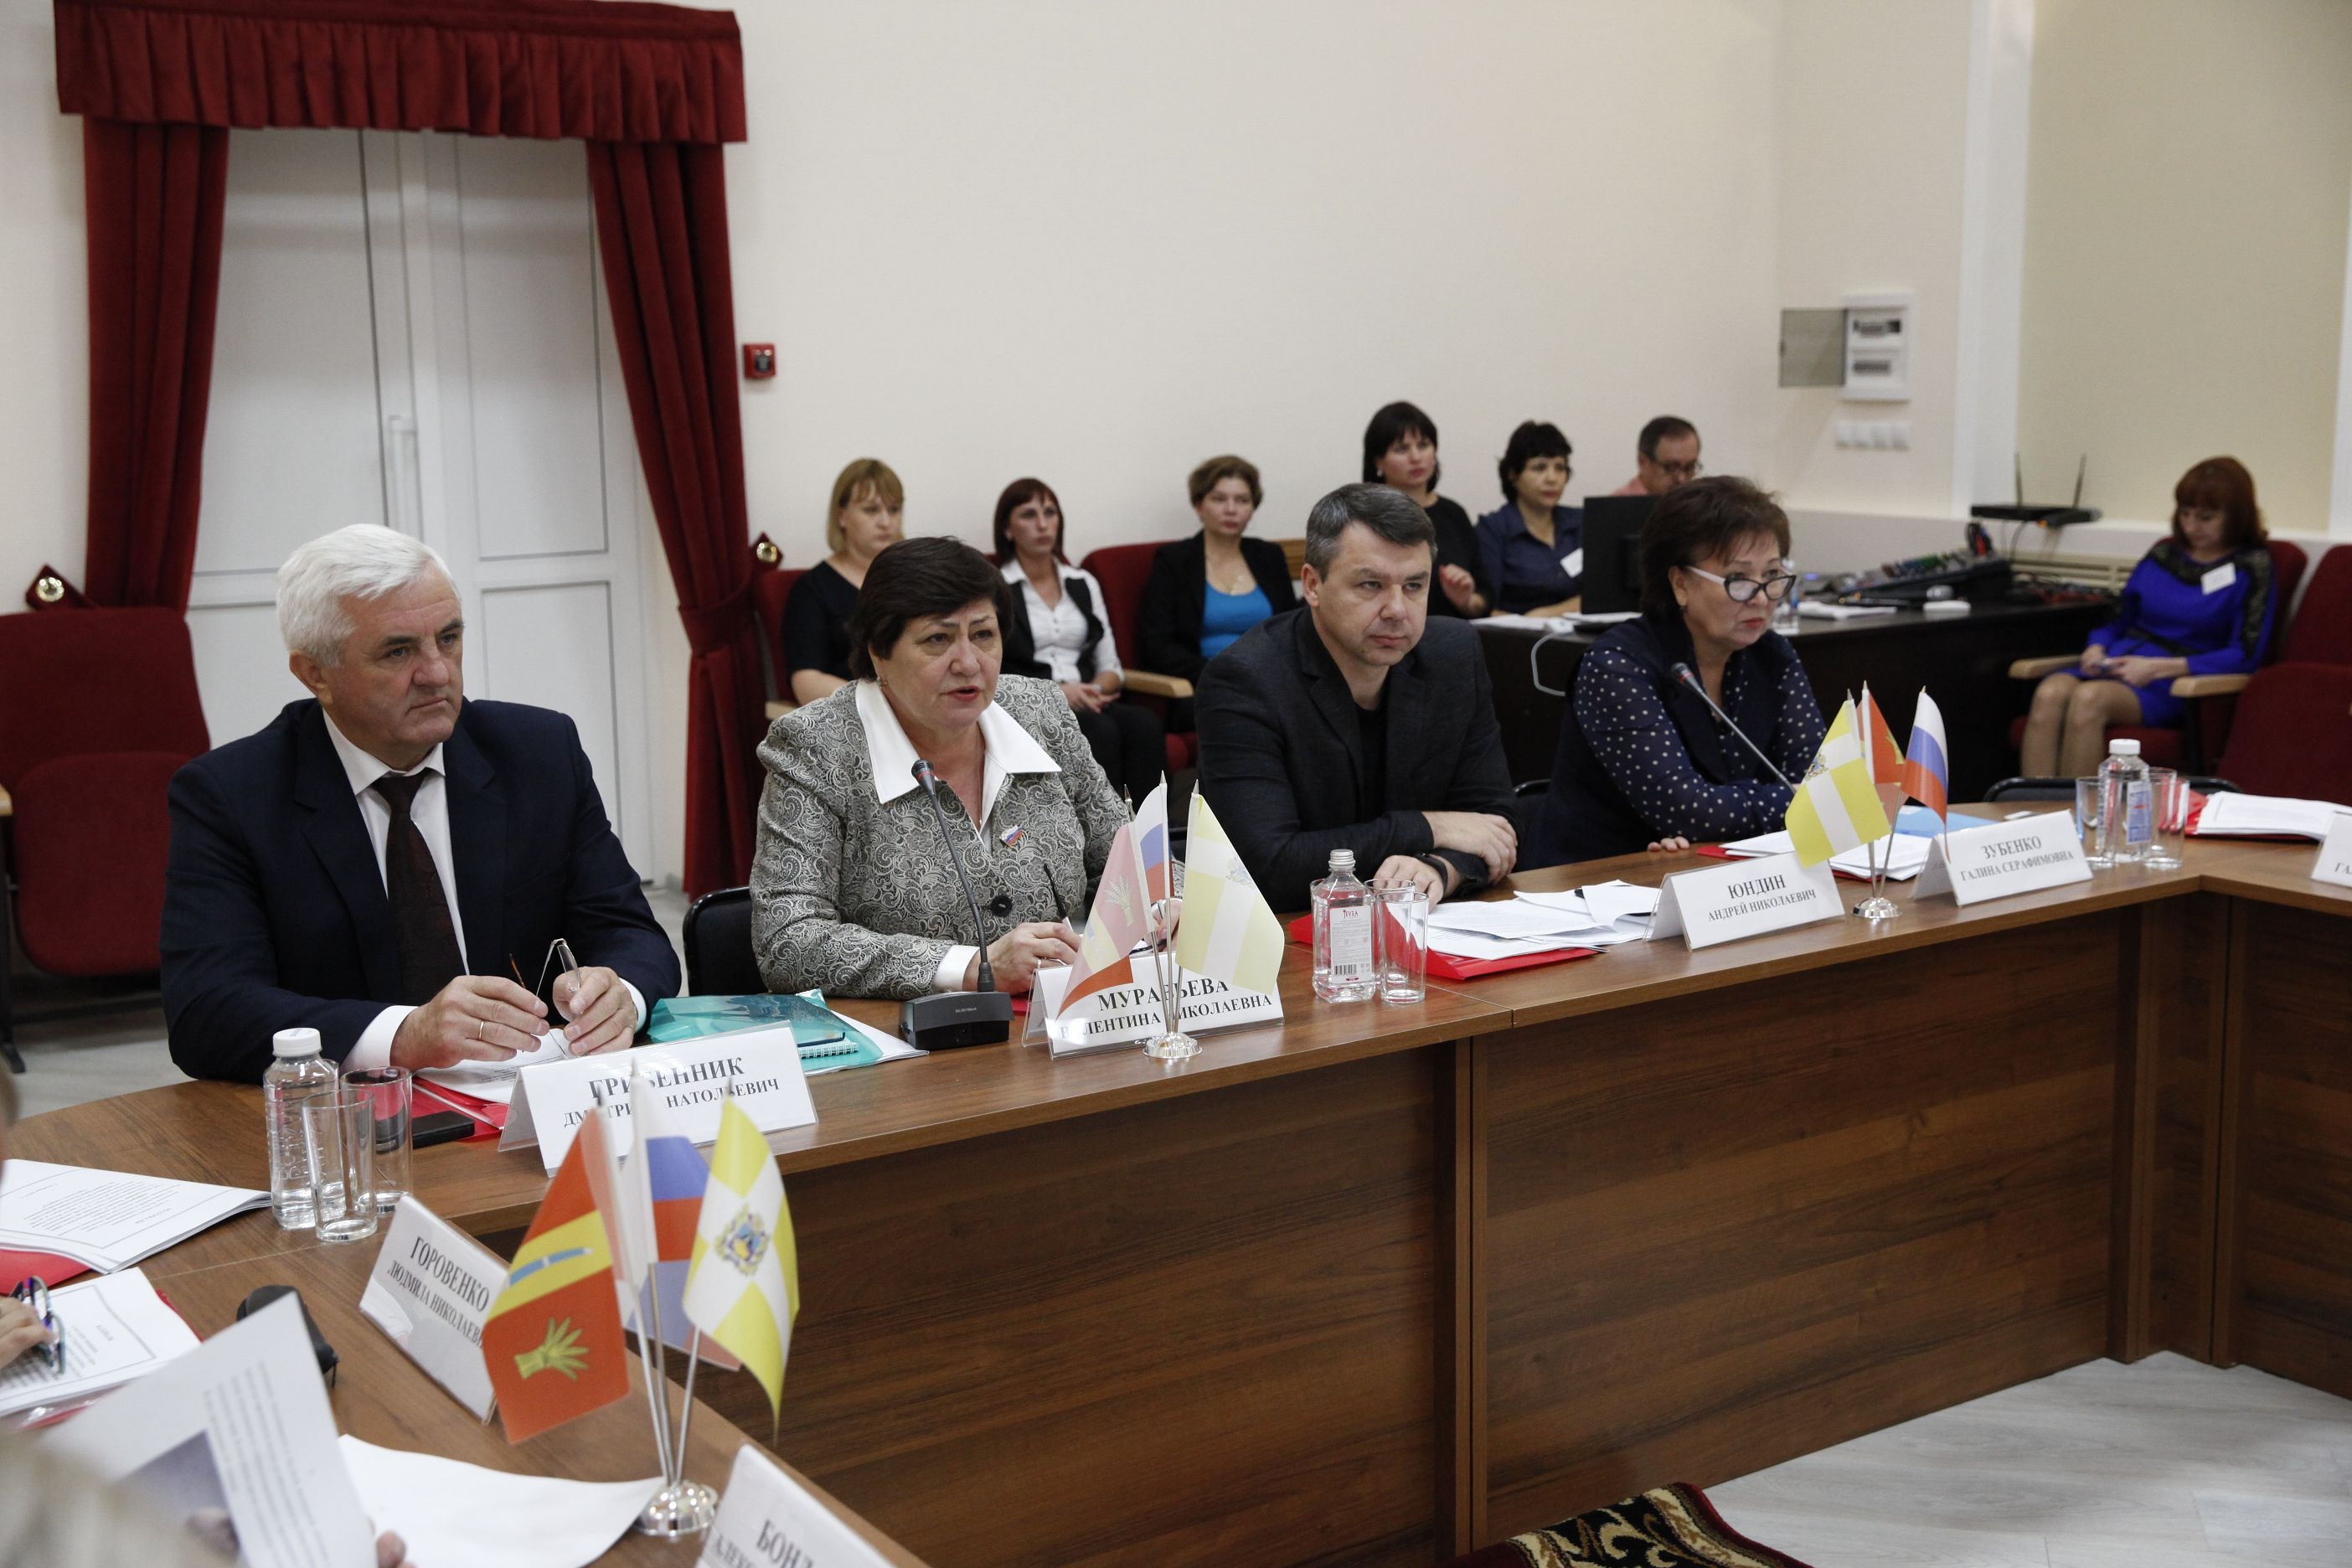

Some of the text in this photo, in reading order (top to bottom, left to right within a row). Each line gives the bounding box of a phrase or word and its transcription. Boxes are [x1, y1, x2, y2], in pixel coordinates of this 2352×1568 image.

[1961, 865, 2002, 882] ГАЛИНА
[2002, 850, 2075, 873] СЕРАФИМОВНА
[1980, 836, 2042, 859] ЗУБЕНКО
[1708, 889, 1817, 922] АНДРЕЙ НИКОЛАЕВИЧ
[1727, 874, 1787, 900] ЮНДИН
[1060, 993, 1273, 1039] ВЛЕНТИНА ИКОЛАЕВНА
[589, 1057, 745, 1099] ГРИЕННИК
[387, 1259, 430, 1306] ЛЮДМИЛА
[410, 1235, 489, 1312] ГОРОВЕНКО
